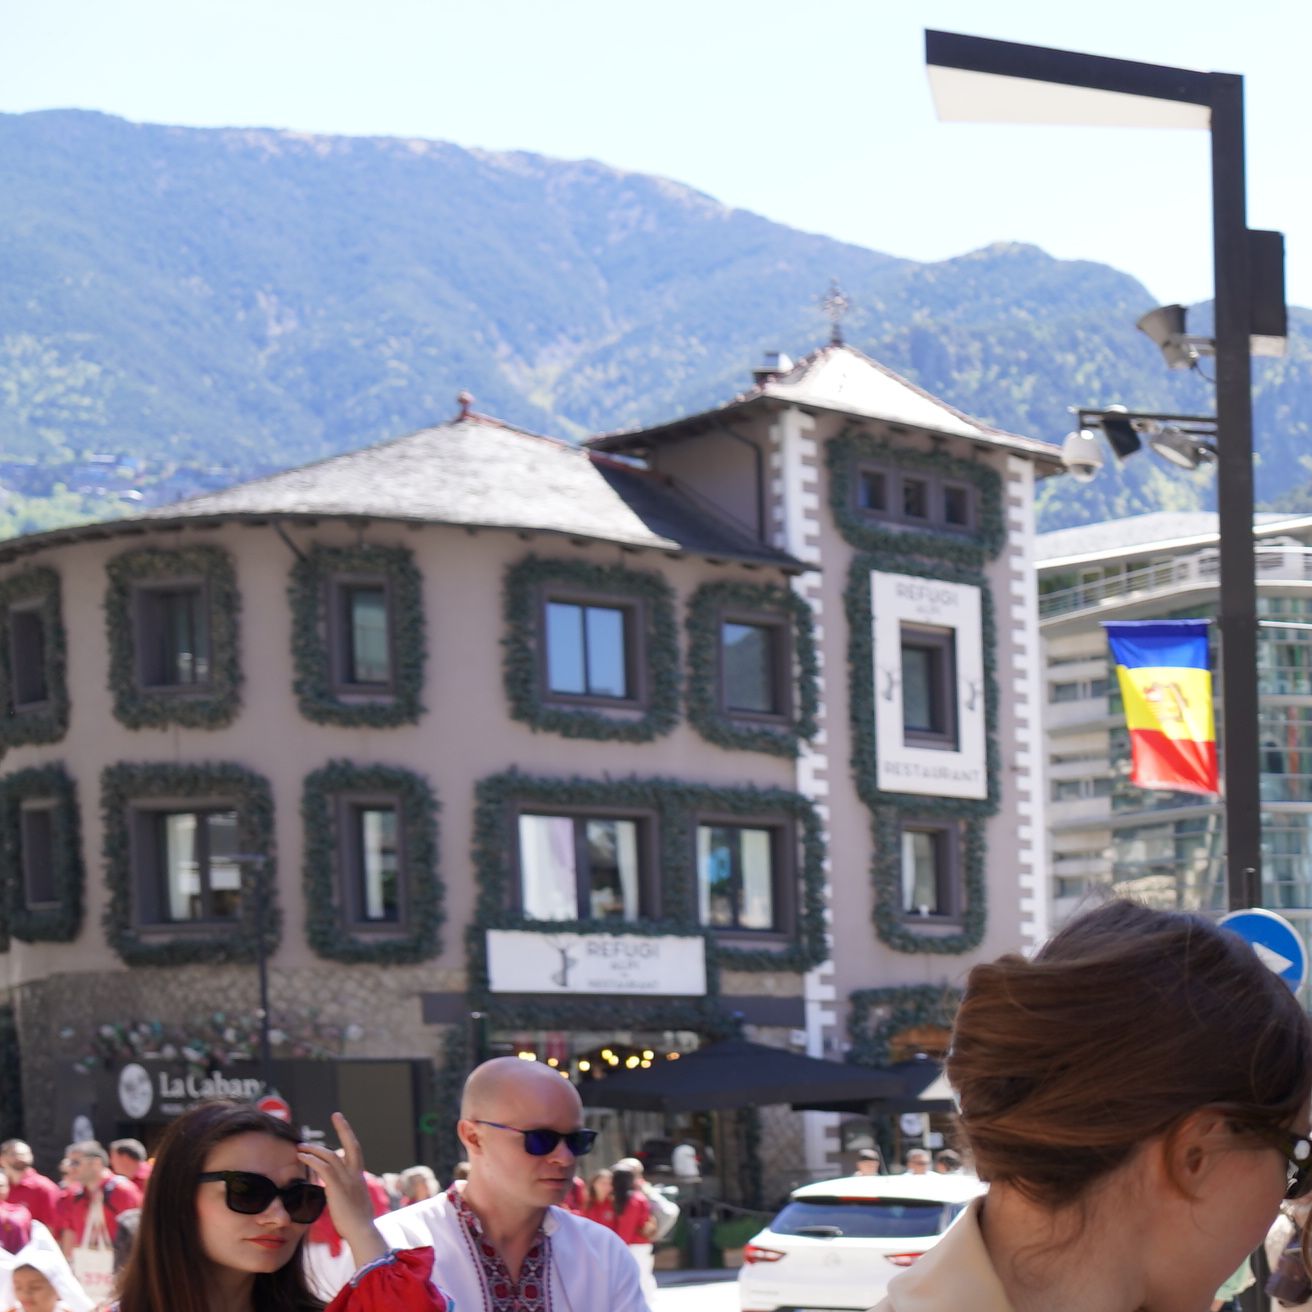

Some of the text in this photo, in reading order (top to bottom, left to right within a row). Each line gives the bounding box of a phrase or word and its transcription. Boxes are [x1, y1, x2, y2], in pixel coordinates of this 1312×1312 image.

[896, 583, 958, 607] REFUGI
[884, 761, 980, 782] RESTAURANT
[586, 941, 660, 959] REFUGI
[159, 1072, 185, 1097] La
